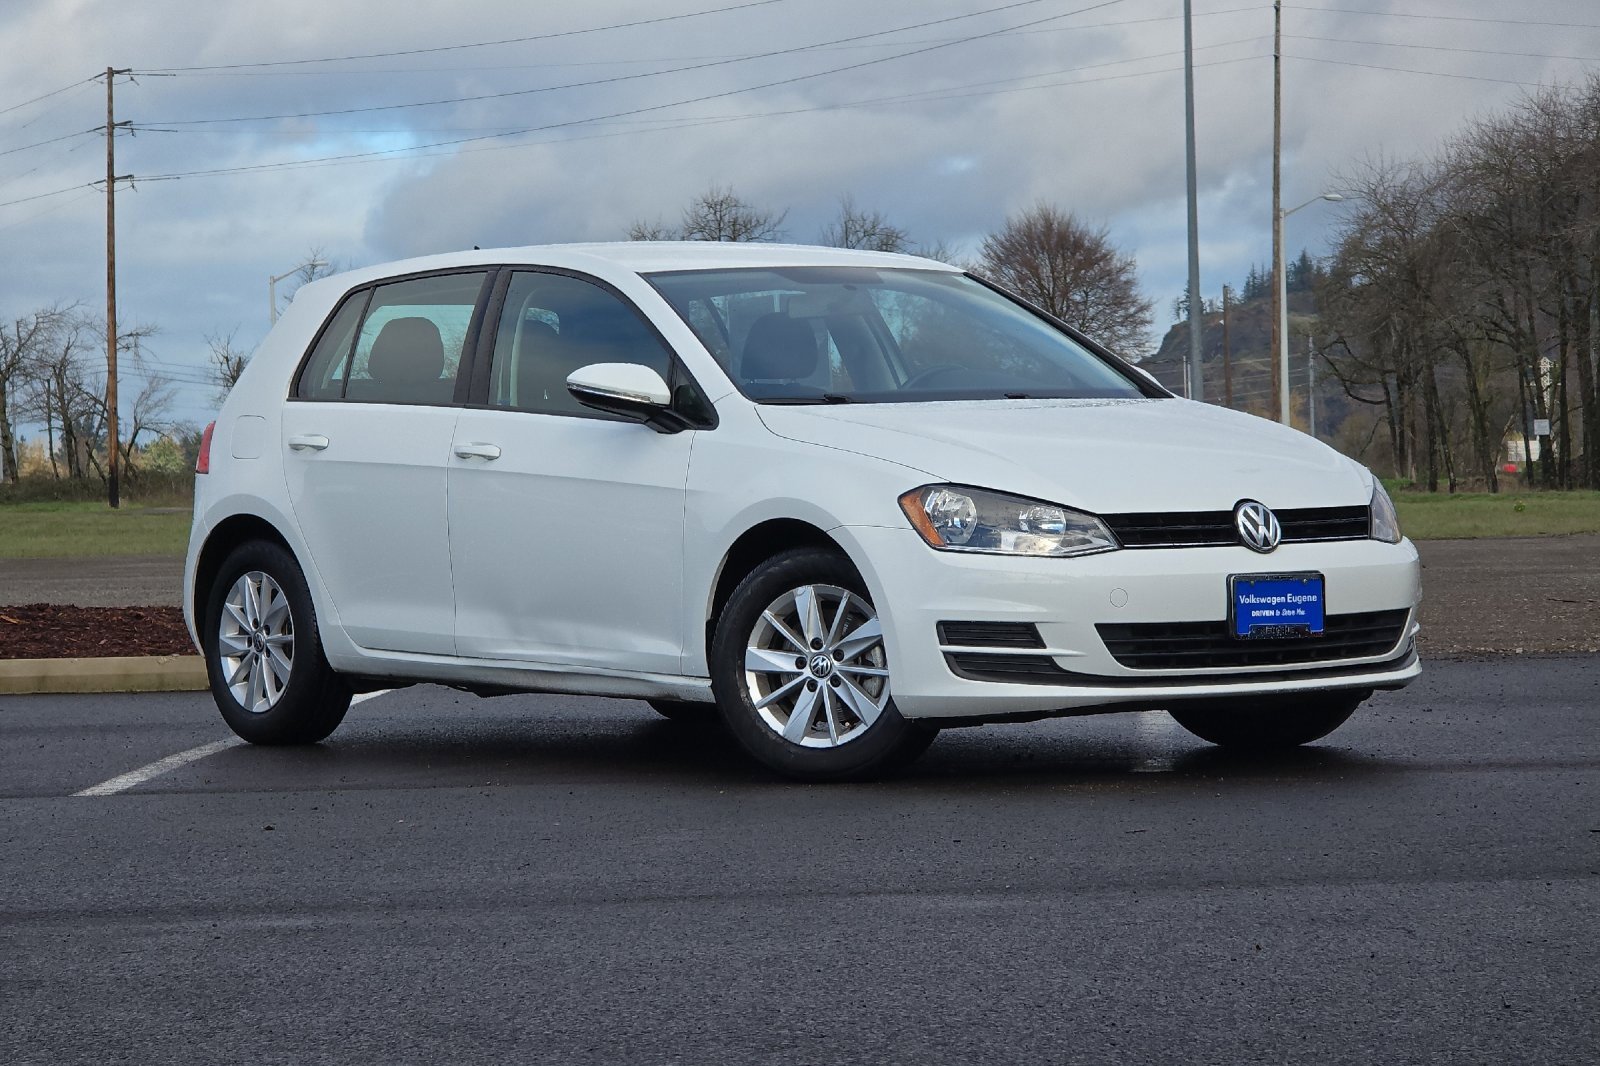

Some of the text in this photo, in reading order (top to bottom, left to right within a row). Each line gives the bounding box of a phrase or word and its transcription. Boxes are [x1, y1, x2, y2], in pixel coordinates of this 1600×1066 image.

[1237, 502, 1281, 551] VW
[1239, 593, 1317, 605] Volkswagen Eugene
